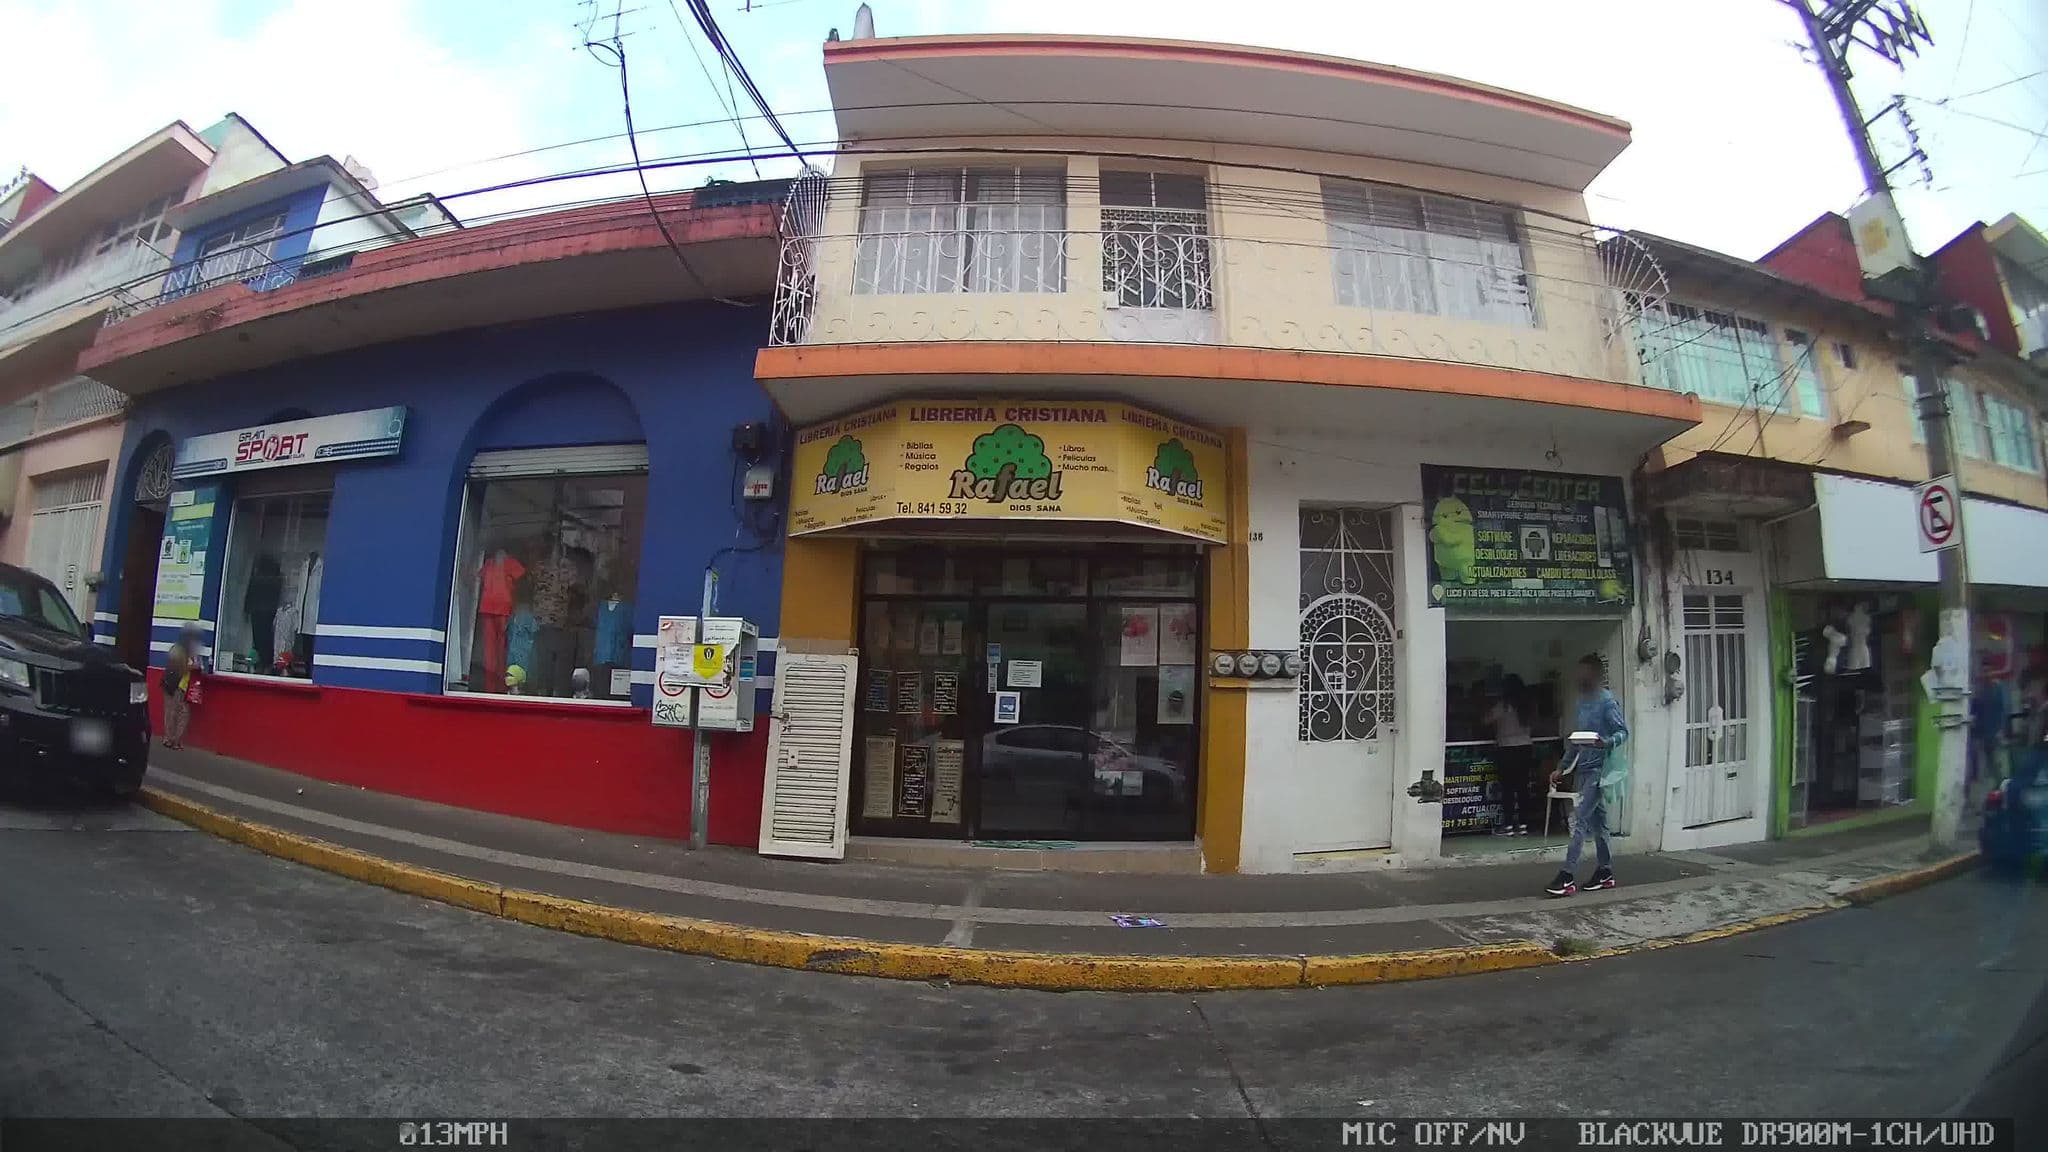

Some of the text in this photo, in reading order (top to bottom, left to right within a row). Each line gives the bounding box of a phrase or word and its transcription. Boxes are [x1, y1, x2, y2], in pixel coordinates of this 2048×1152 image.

[910, 407, 1107, 422] LIBRERIA CRISTIANA
[800, 408, 897, 444] LIBRERIA CRISTIANA
[1121, 409, 1222, 448] LIBRERIA CRISTIANA
[235, 433, 308, 462] SPORT
[1063, 445, 1086, 453] Libros
[905, 463, 938, 472] Regalos
[1063, 463, 1089, 471] Mucho
[814, 463, 870, 495] Rafael
[948, 462, 1063, 503] Rafael
[1146, 465, 1203, 500] Rafael
[896, 502, 967, 514] Tel. 841 59 32
[1010, 504, 1062, 512] DIOS SANA
[1477, 530, 1513, 543] SOFTWARE
[1467, 567, 1527, 578] ACTUALIZACIONES
[1536, 567, 1562, 579] CAMBIO
[1562, 568, 1572, 579] DE
[1706, 569, 1733, 586] 134
[1446, 786, 1481, 795] SOFTWARE
